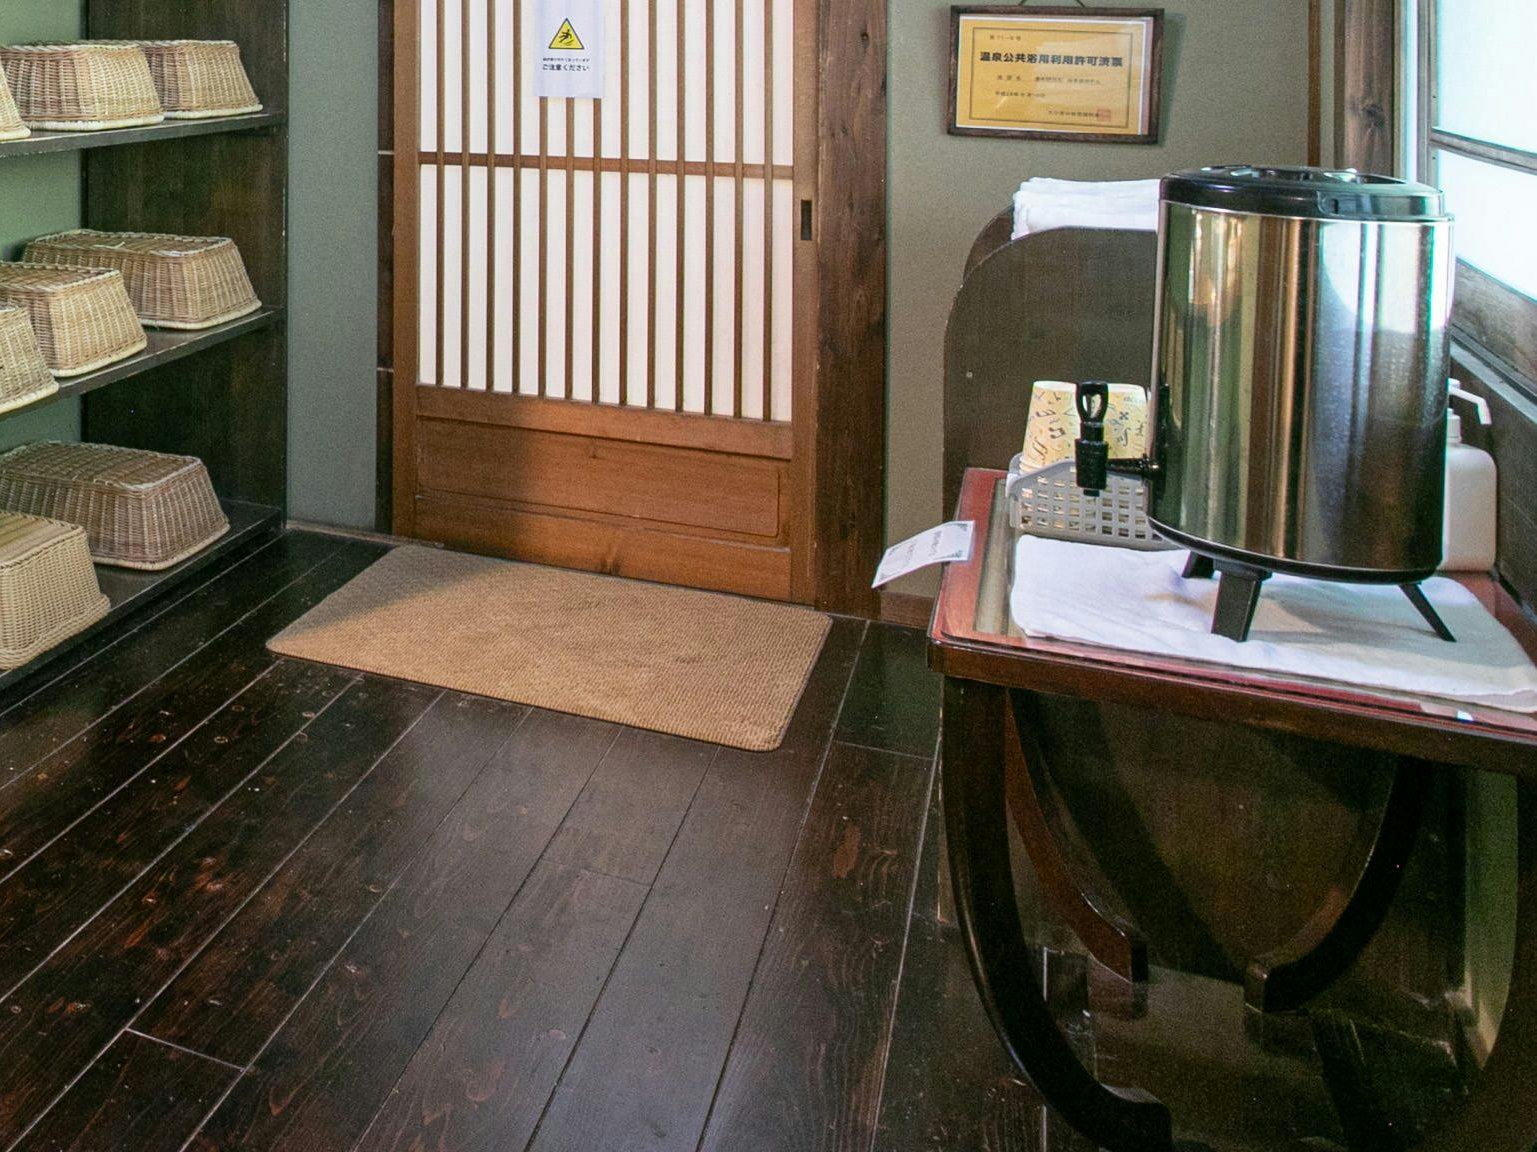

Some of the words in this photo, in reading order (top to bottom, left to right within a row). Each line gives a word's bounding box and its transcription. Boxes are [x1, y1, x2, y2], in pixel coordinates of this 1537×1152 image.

[979, 51, 1124, 68] 温泉公共浴用利用許可済票
[542, 64, 590, 72] ご注意ください
